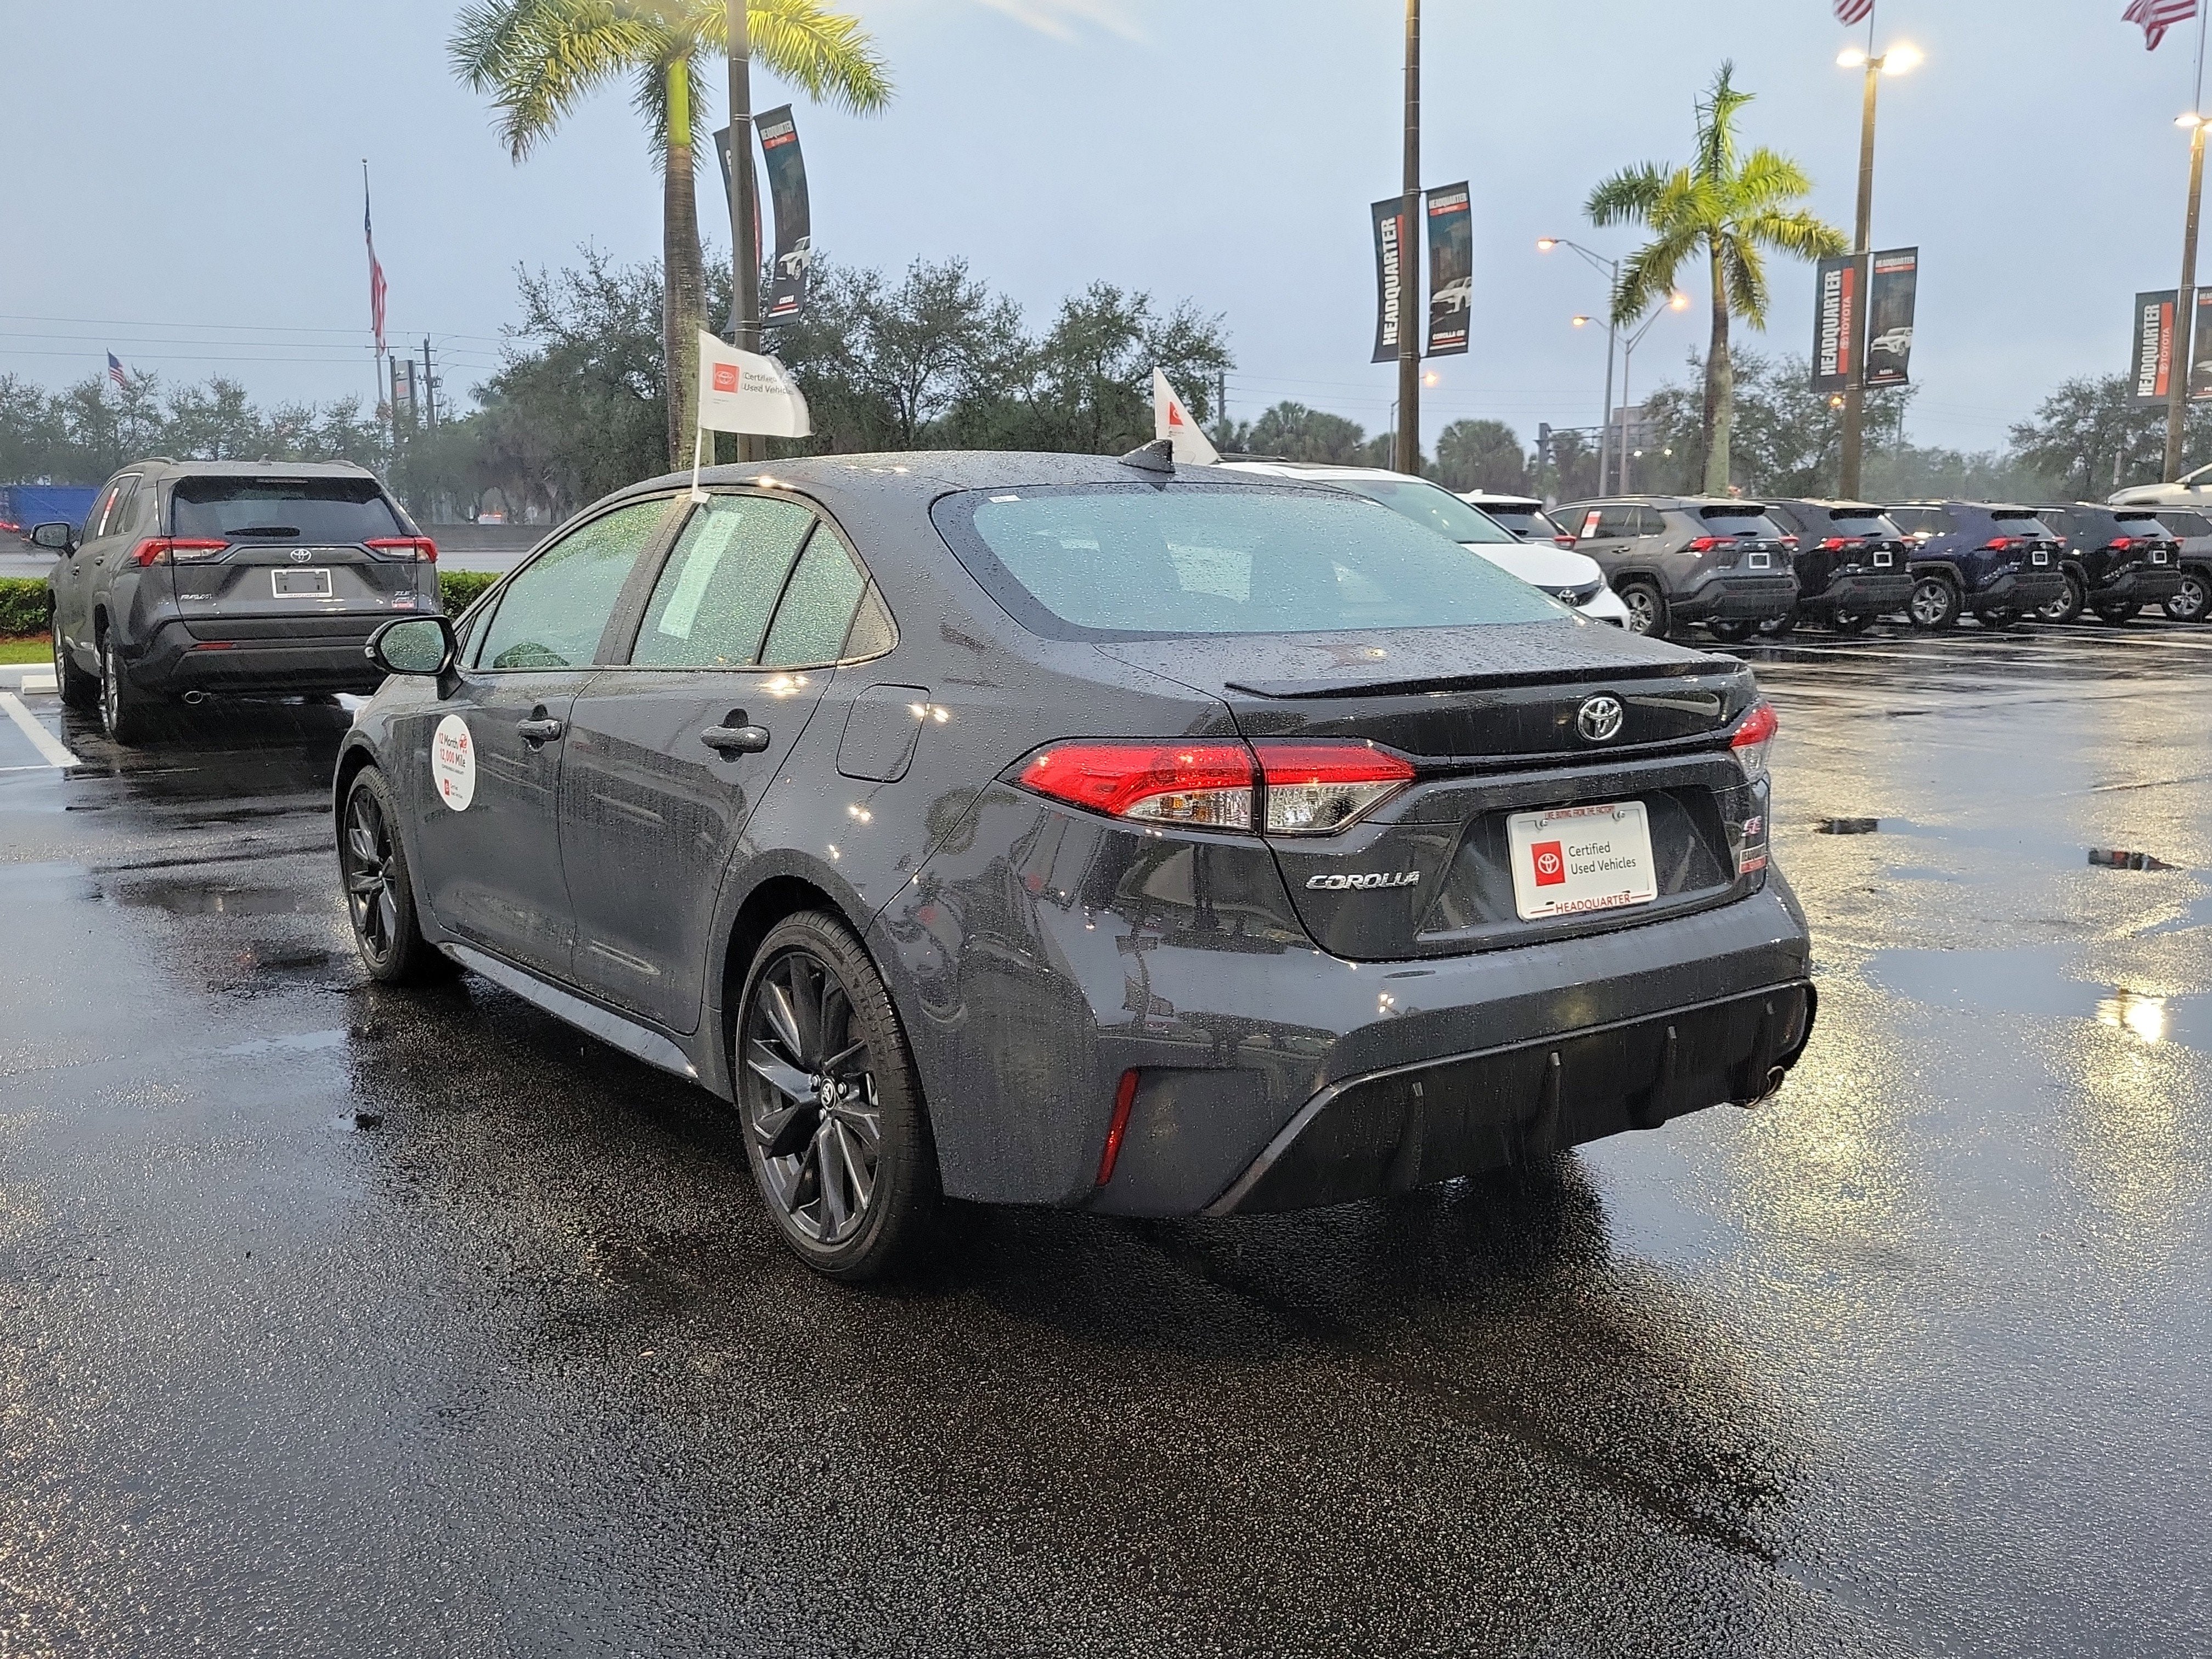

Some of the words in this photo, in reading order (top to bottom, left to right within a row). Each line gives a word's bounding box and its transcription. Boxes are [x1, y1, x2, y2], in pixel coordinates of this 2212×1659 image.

[1381, 217, 1401, 346] HEADQUARTER
[1820, 269, 1841, 376] HEADQUARTER
[2137, 304, 2160, 397] HEADQUARTER
[744, 382, 763, 393] Used
[1568, 842, 1610, 857] Certified
[1571, 862, 1595, 874] Used
[1597, 857, 1637, 872] Vehicles
[1306, 871, 1420, 890] COROLLA
[1555, 894, 1631, 914] HEADQUARTER
